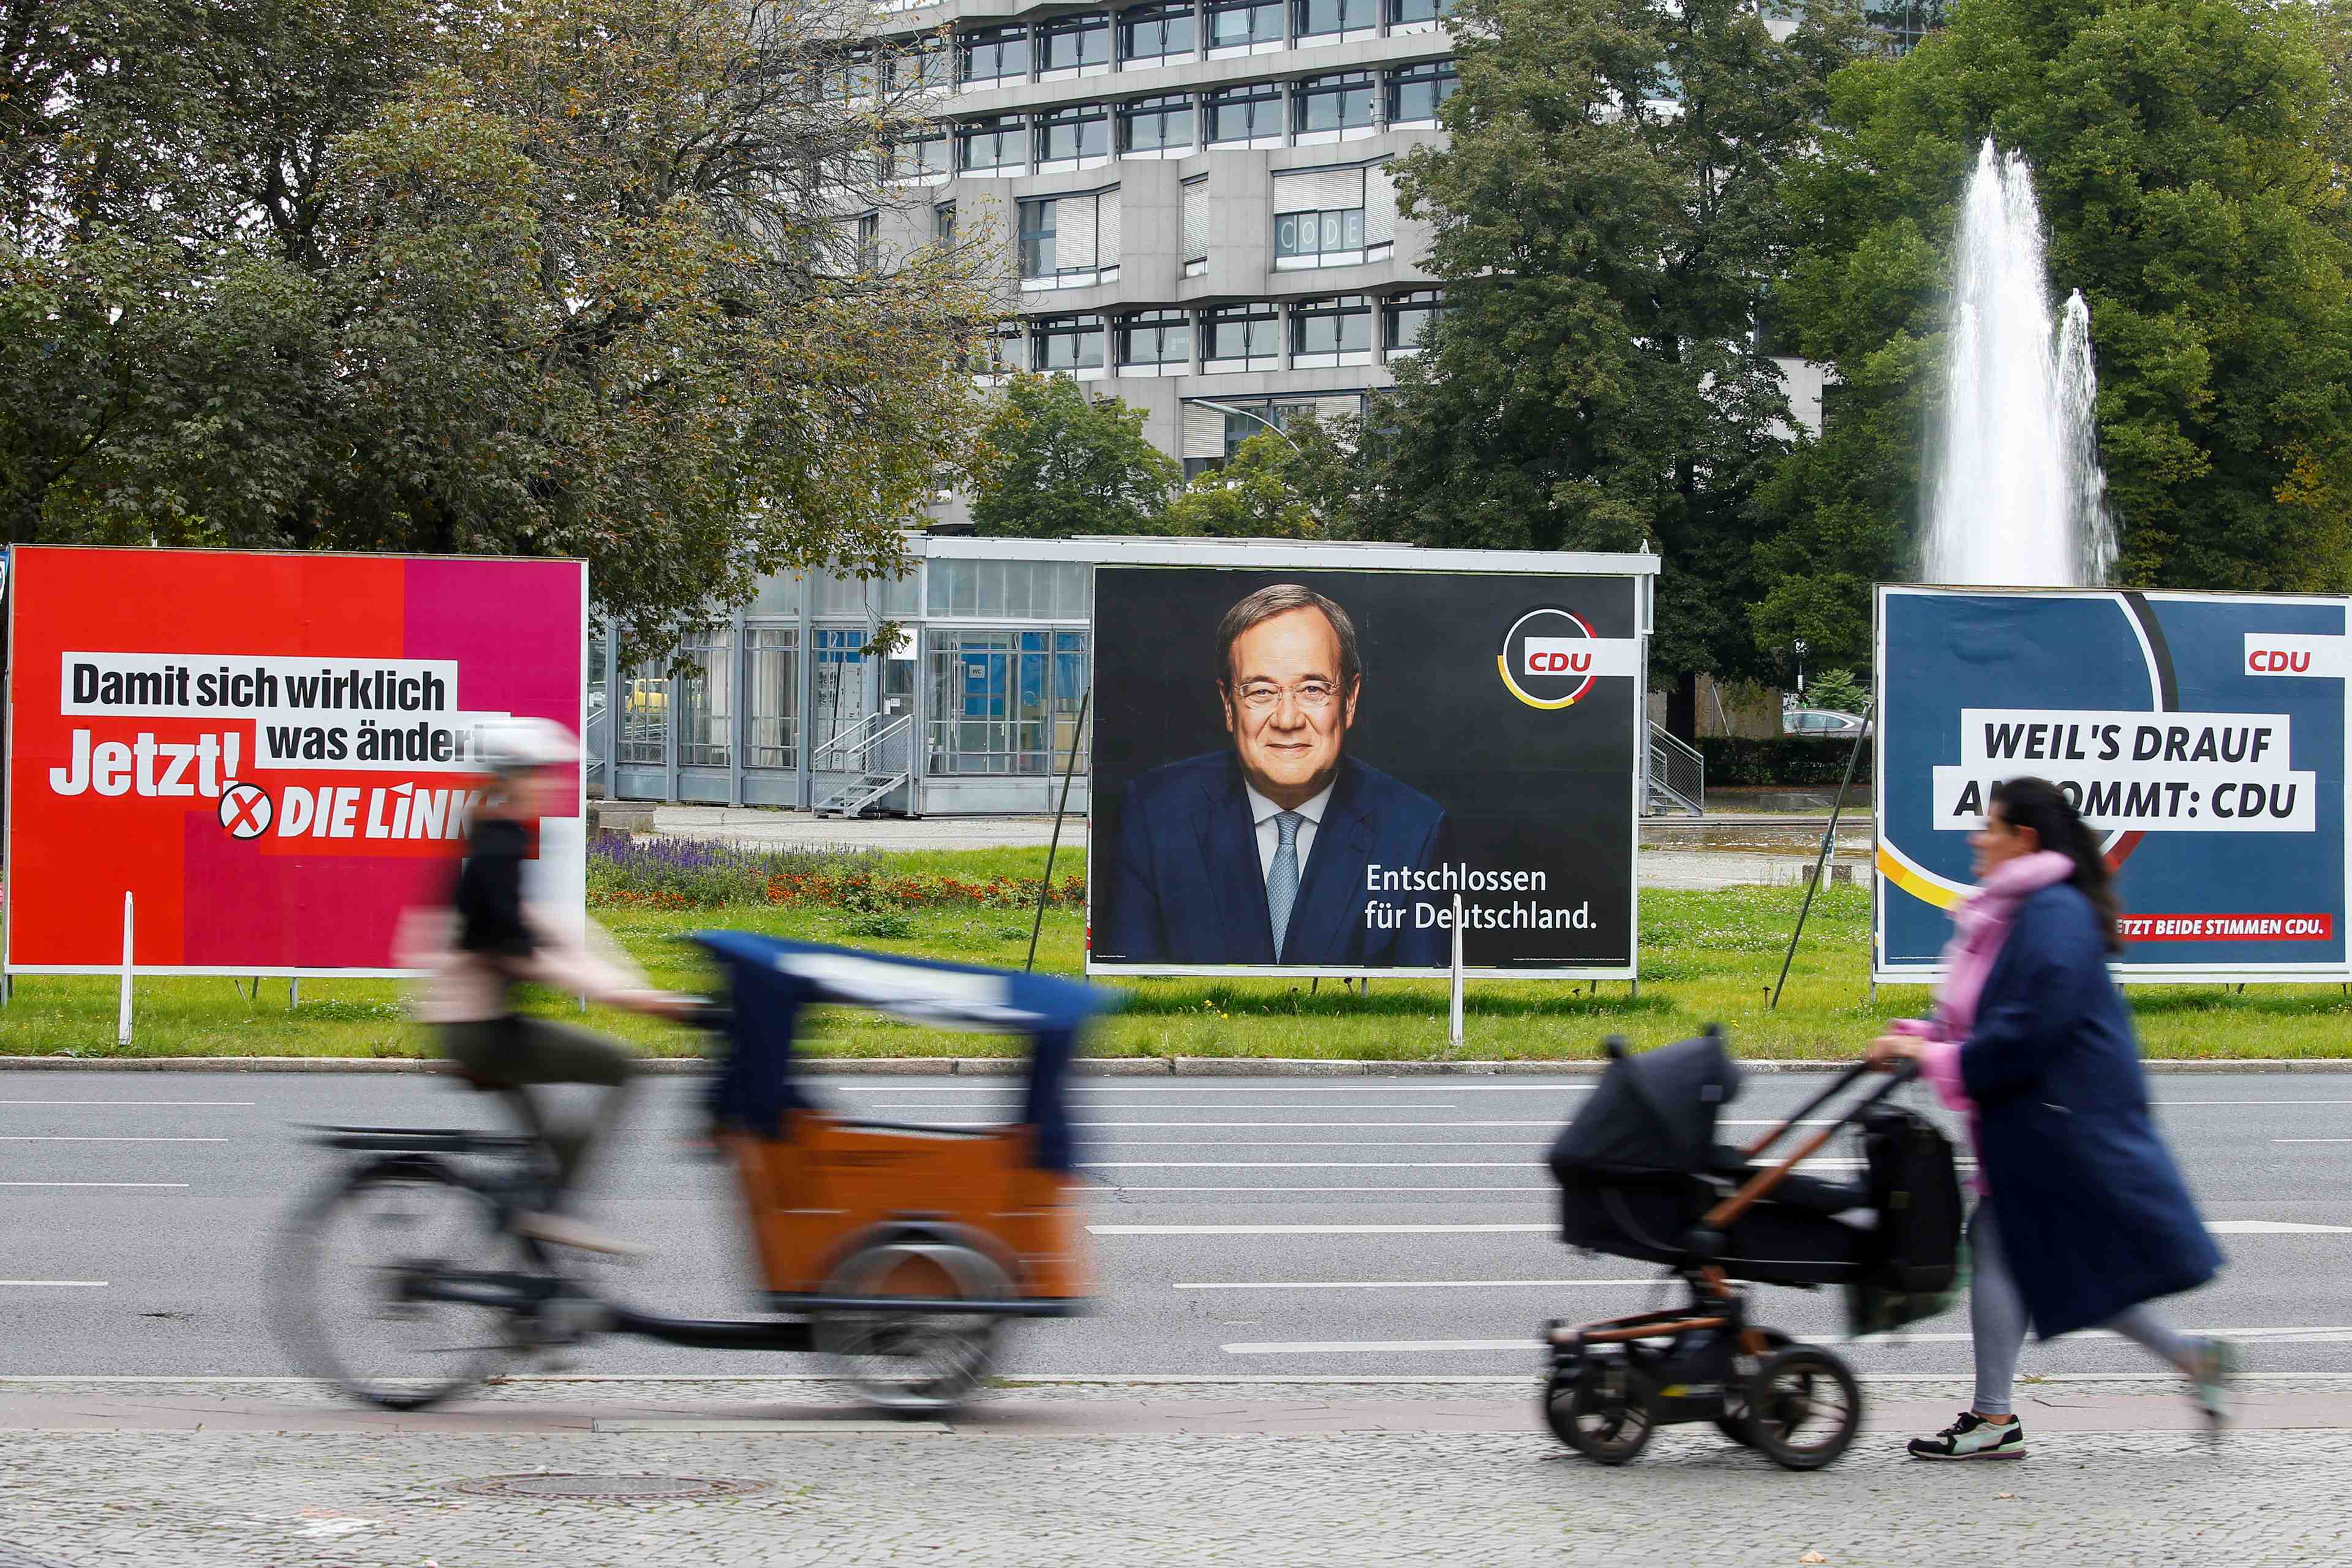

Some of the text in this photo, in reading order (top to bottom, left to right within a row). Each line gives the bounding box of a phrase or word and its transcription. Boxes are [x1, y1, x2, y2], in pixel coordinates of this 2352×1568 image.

[1281, 216, 1358, 248] CODE
[1529, 653, 1591, 672] CDU
[2249, 650, 2311, 672] CDU
[73, 663, 445, 711] Damit sich wirklich
[266, 726, 348, 760] was
[1985, 723, 2272, 763] WEIL'S DRAUF
[49, 729, 240, 797] Jetzt!
[277, 786, 361, 838] DIE
[1953, 780, 2297, 818] AOMMT: CDU
[1366, 862, 1547, 891] Entschlossen
[1365, 900, 1597, 929] für Deutschland.
[2116, 919, 2324, 935] ETZT BEIDE STIMMEN CDU.
